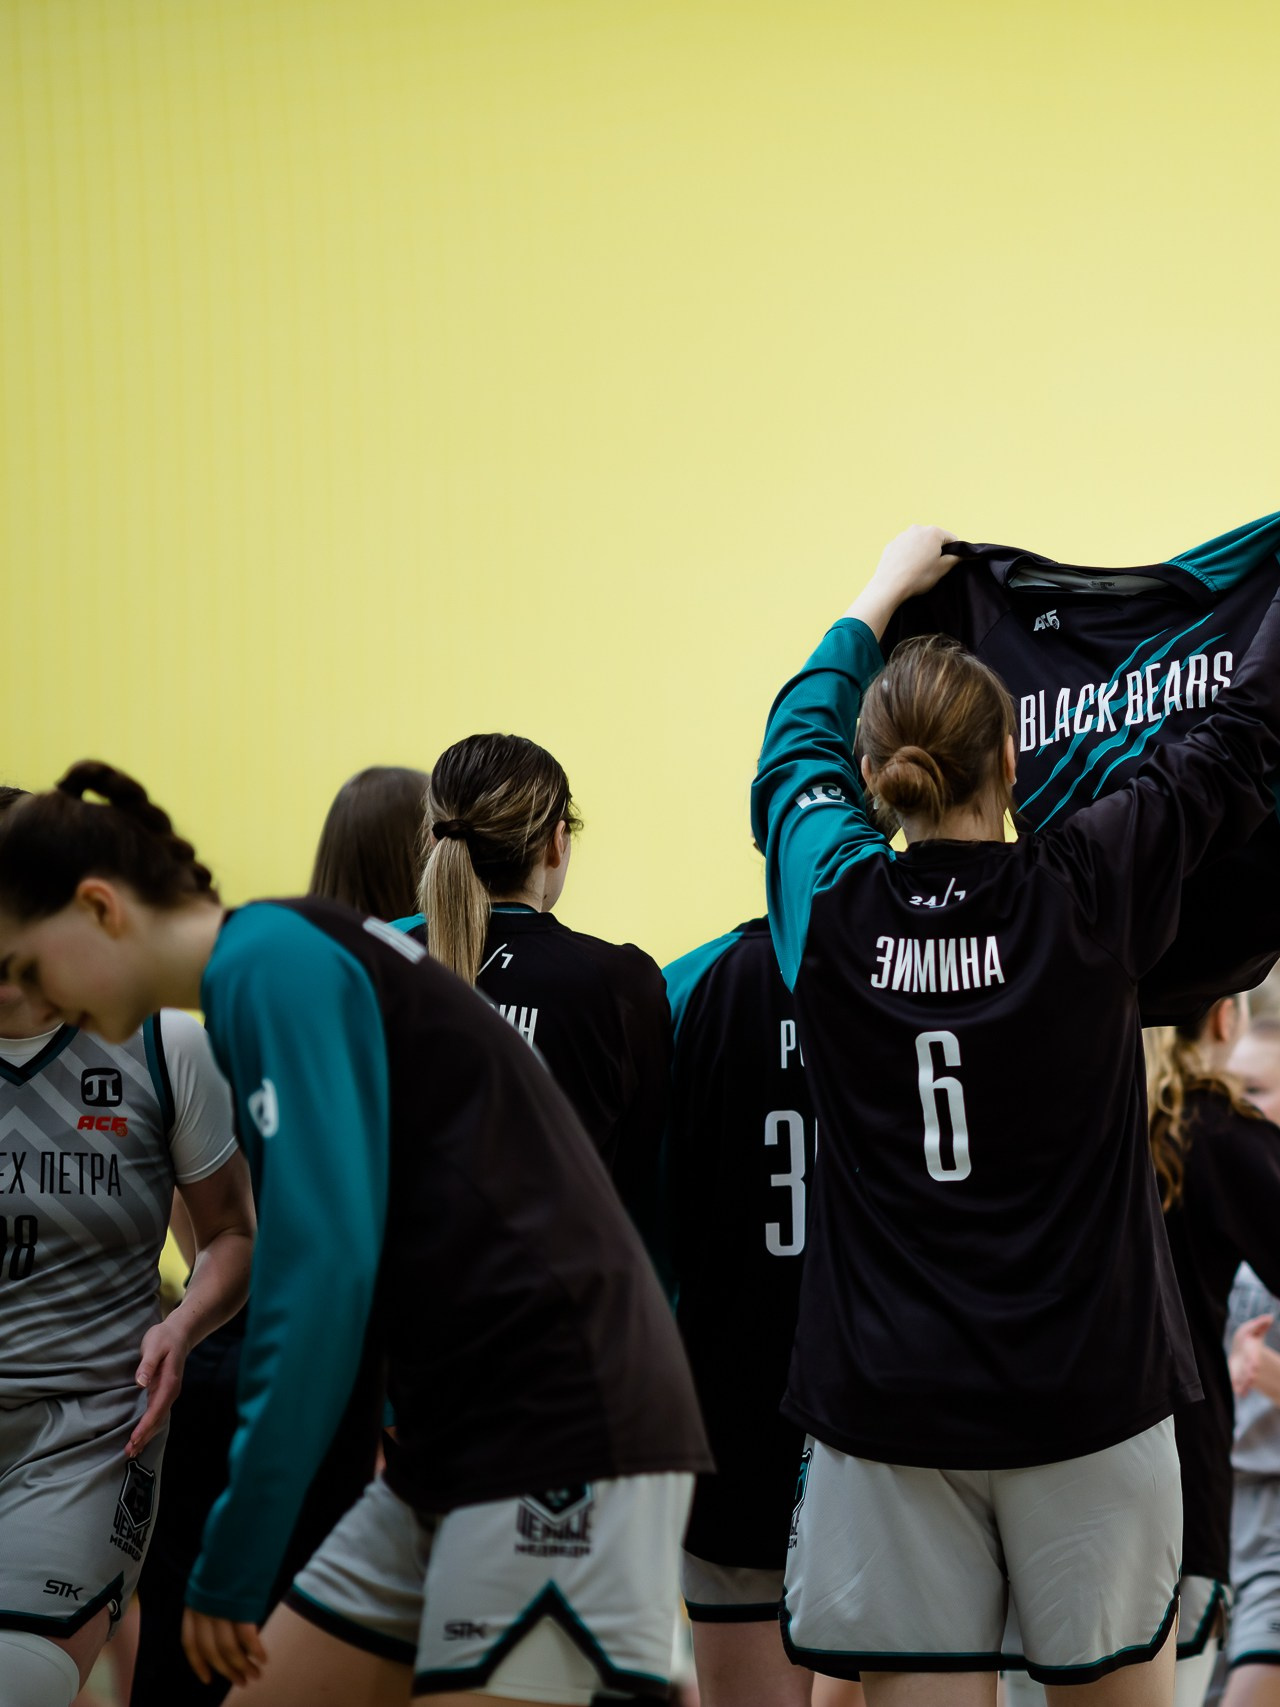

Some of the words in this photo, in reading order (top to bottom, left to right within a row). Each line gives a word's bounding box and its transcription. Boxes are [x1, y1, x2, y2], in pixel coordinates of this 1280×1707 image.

[1020, 679, 1119, 752] BLACK
[1125, 651, 1233, 726] BEARS
[870, 935, 1006, 993] ЗИМИНА
[915, 1031, 972, 1182] 6
[39, 1151, 122, 1197] ПЕТРА
[764, 1110, 818, 1257] 3
[43, 1579, 84, 1601] STK
